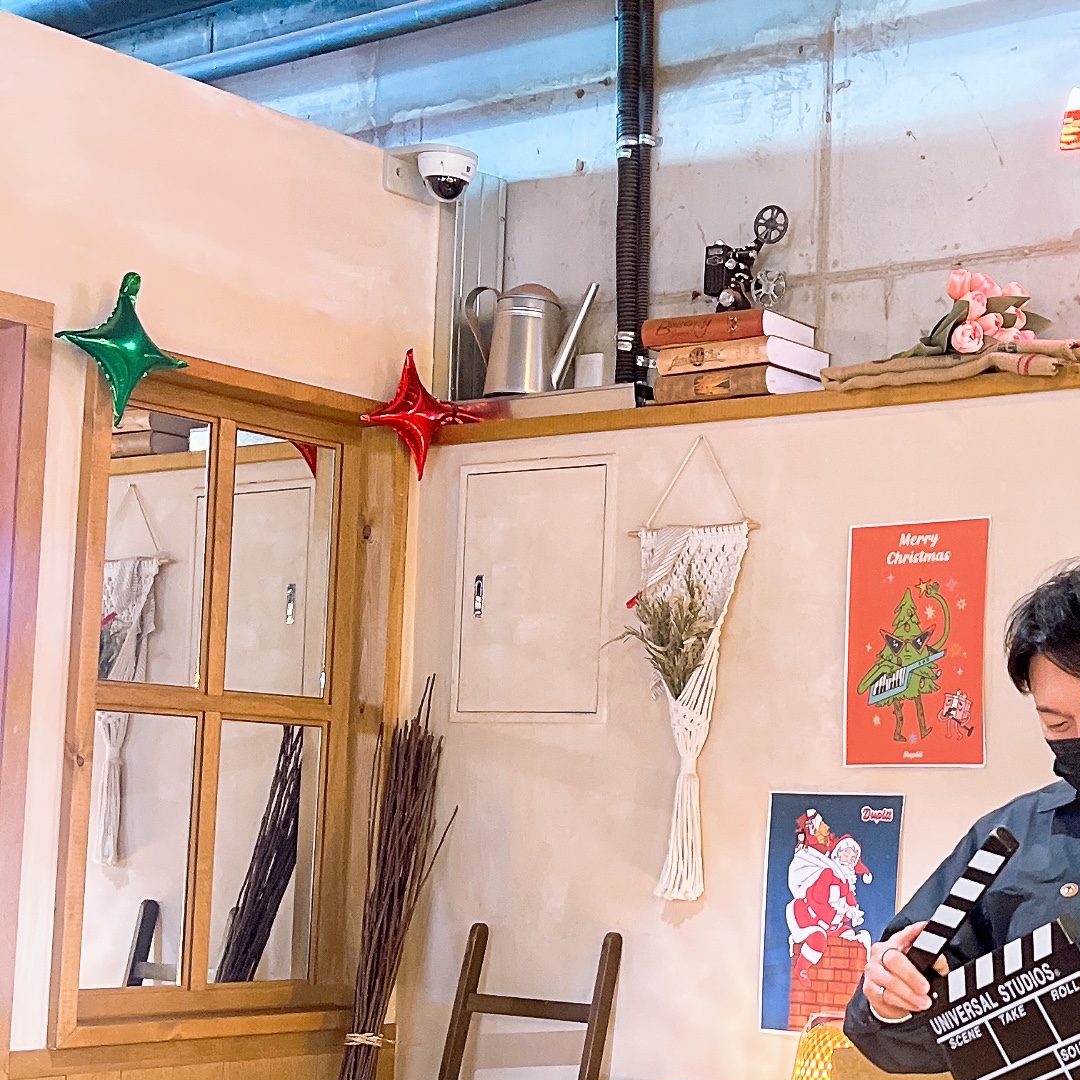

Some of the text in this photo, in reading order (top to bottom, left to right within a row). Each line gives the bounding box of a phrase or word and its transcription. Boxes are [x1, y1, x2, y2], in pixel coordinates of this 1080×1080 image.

[898, 532, 940, 547] Merry
[886, 549, 951, 565] Christmas
[929, 962, 1055, 1036] UNIVERSAL STUDIOS
[1050, 980, 1080, 1002] ROLL
[998, 1004, 1027, 1026] TAKE
[948, 1025, 983, 1050] SCENE
